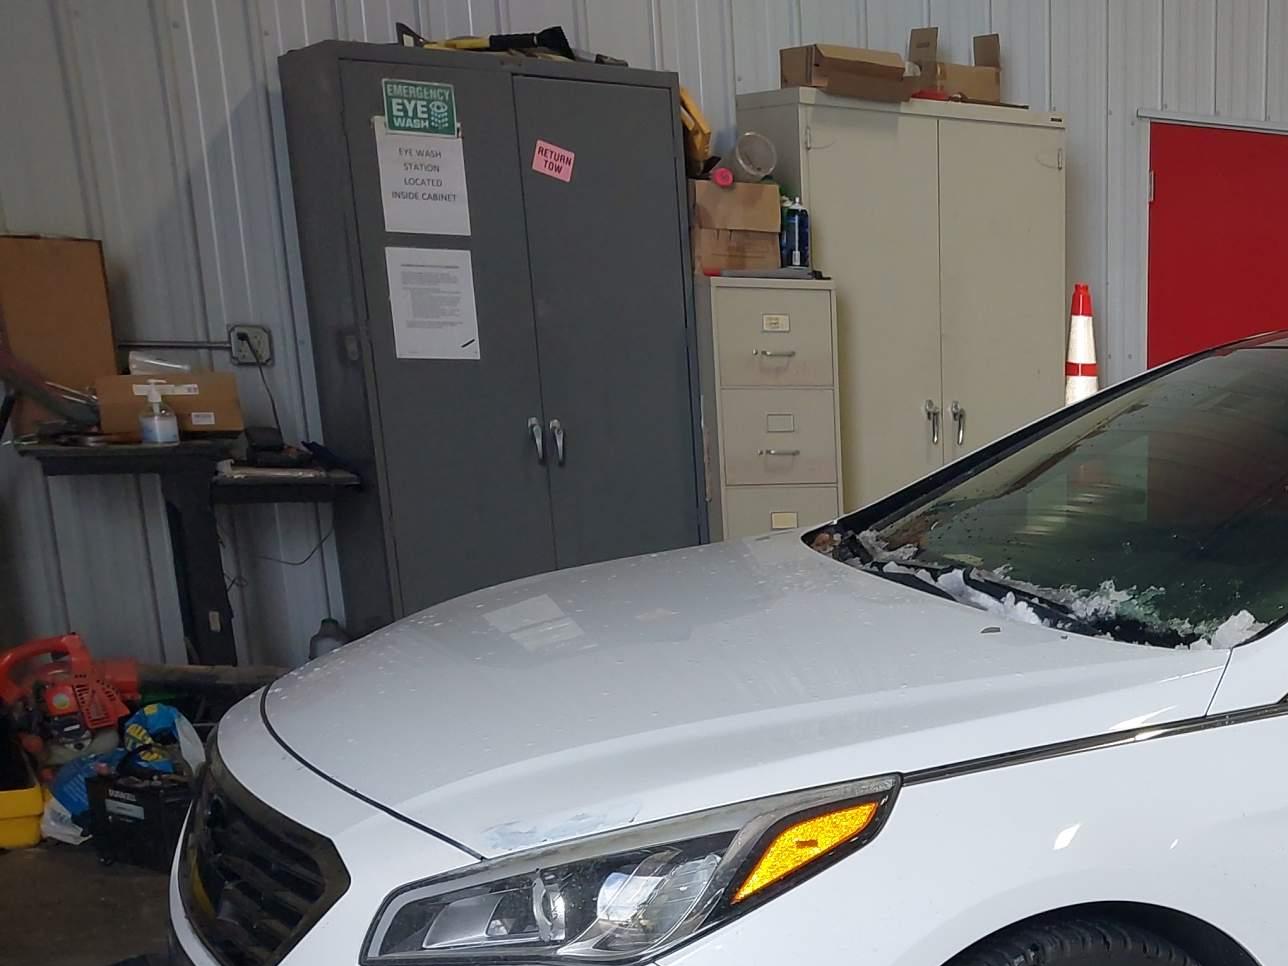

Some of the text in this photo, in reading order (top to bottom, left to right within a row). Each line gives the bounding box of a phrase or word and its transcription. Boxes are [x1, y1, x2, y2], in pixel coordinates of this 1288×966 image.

[386, 84, 450, 101] EMERGENCY
[391, 98, 428, 118] EYE
[393, 117, 429, 128] WASH
[398, 147, 442, 158] EYE WASH
[537, 146, 572, 166] RETURN
[403, 162, 440, 173] STATION
[544, 160, 563, 174] TOW
[403, 177, 443, 187] LOCATED
[391, 191, 457, 202] INSIDE CABINET
